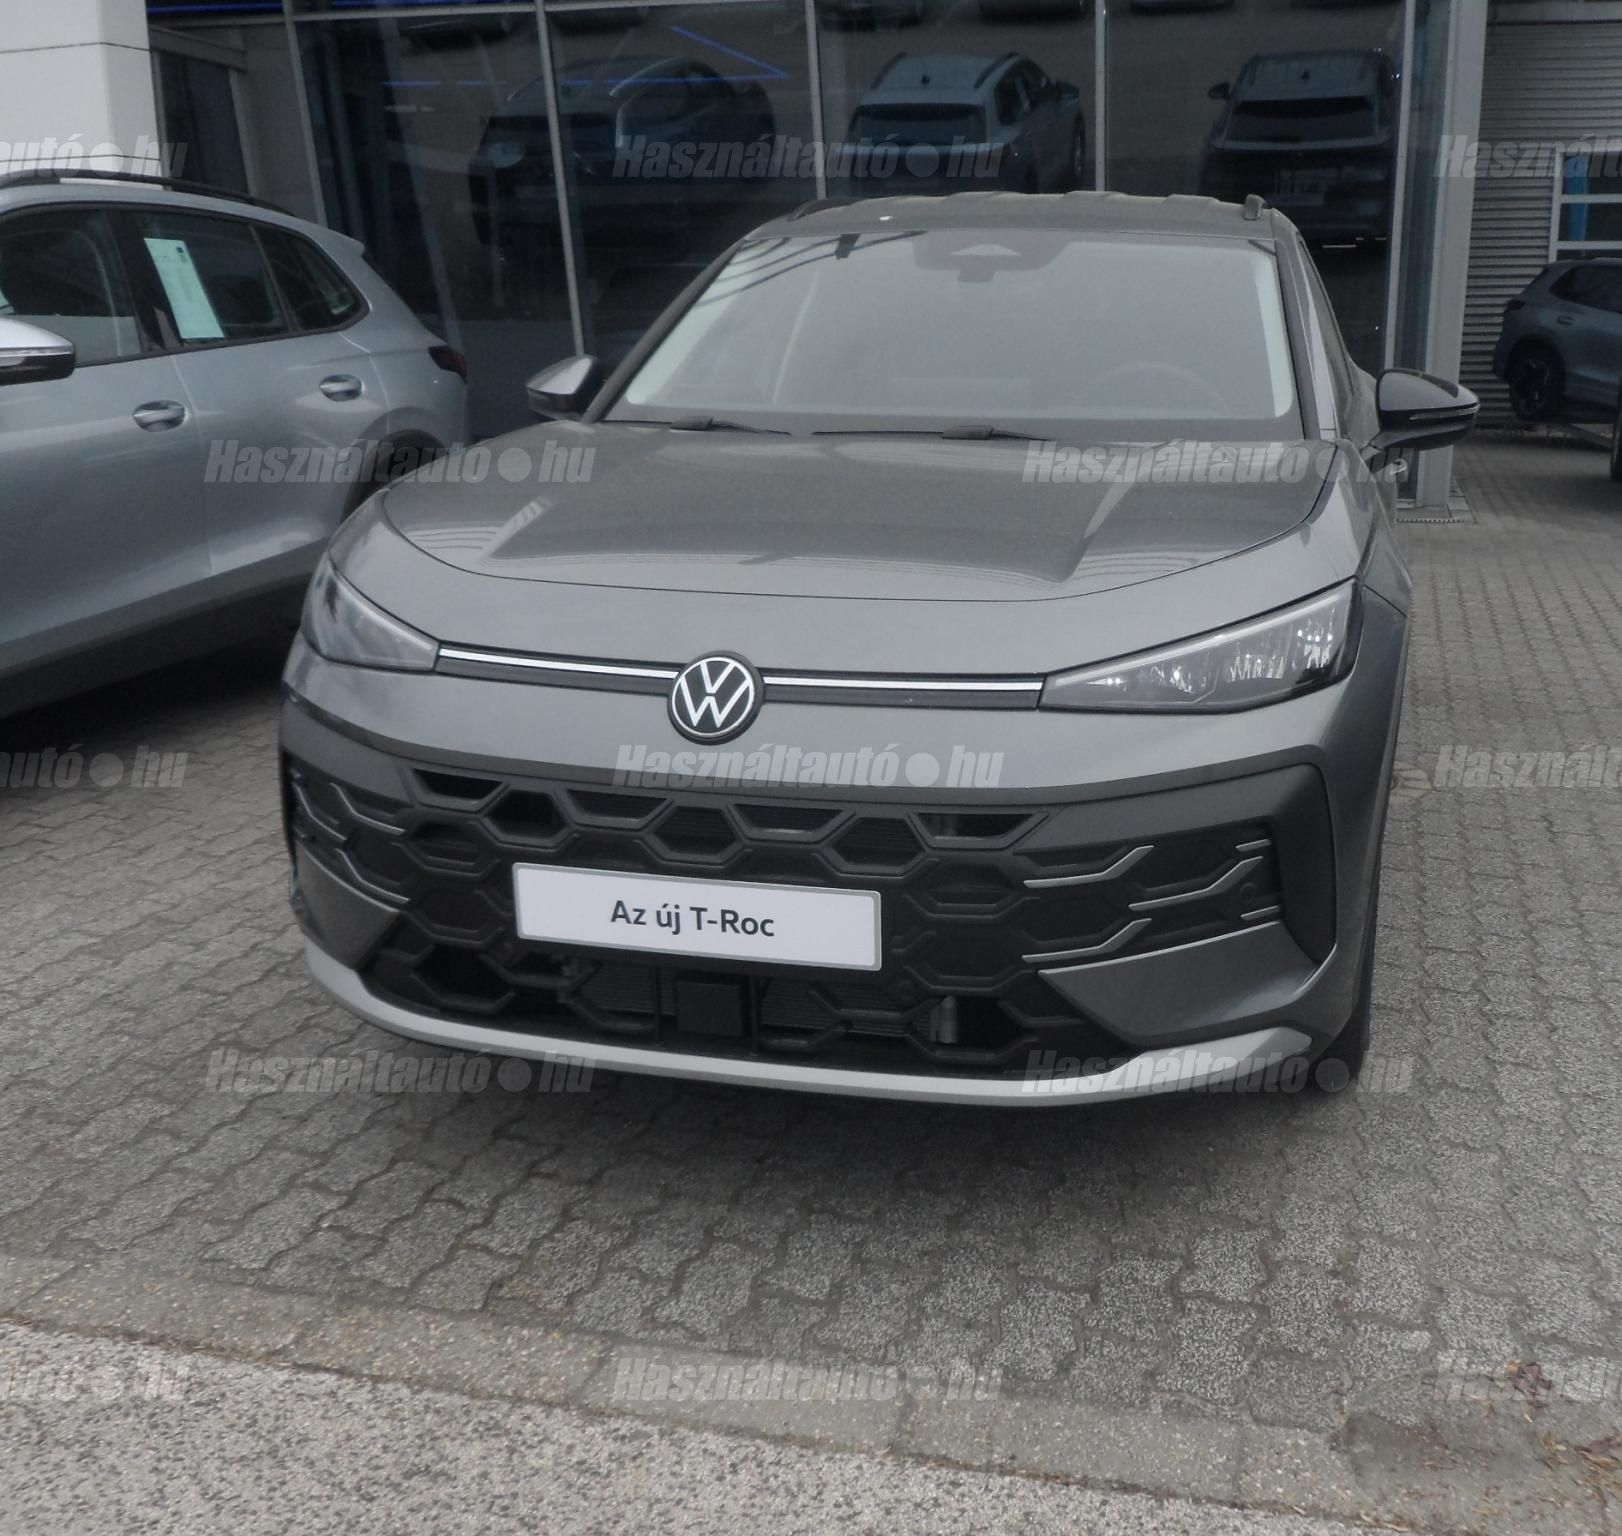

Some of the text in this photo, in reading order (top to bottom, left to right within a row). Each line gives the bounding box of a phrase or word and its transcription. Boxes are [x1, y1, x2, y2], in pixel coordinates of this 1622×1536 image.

[674, 658, 753, 735] VW
[611, 900, 775, 937] Az új T-Roc
